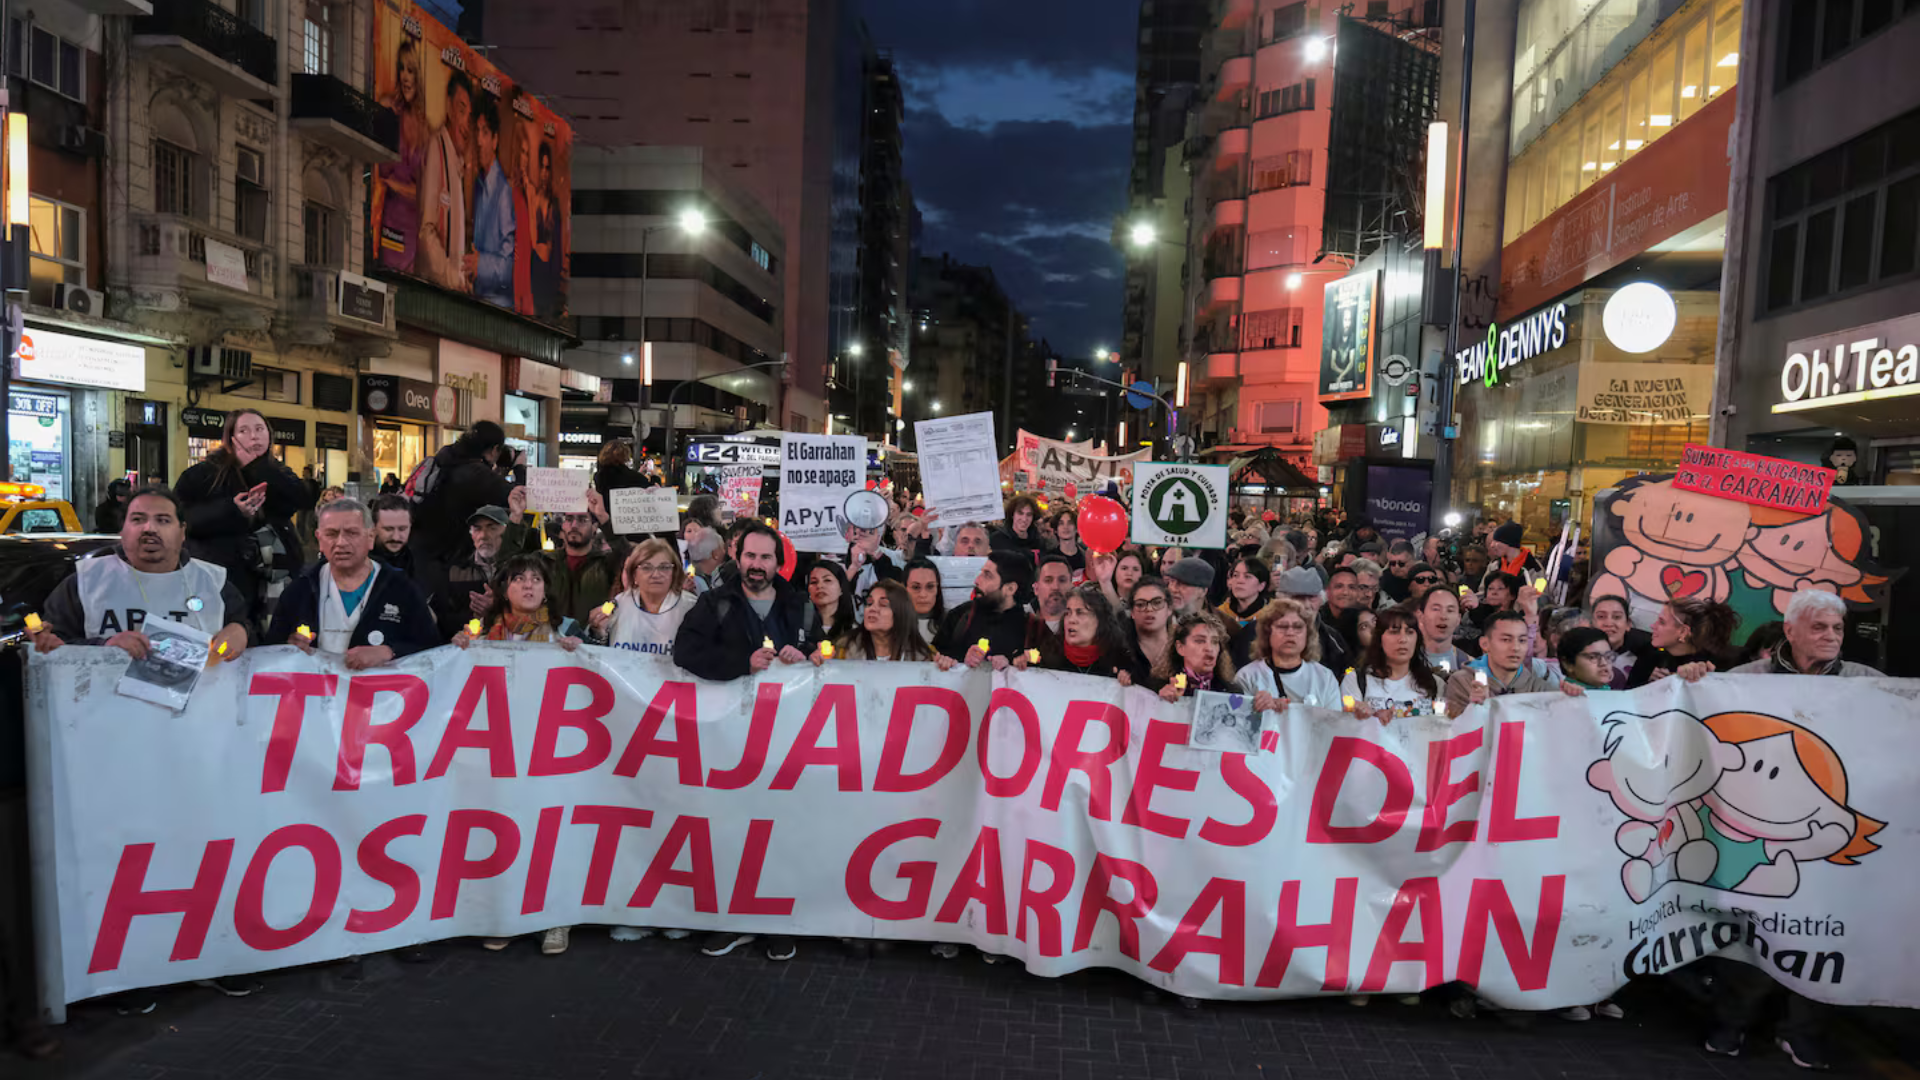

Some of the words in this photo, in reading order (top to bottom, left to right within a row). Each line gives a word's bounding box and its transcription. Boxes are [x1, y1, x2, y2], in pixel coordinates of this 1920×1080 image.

[1565, 199, 1606, 238] TEATRO
[1615, 187, 1652, 220] Instituto
[1613, 213, 1651, 247] Superior
[1652, 204, 1666, 227] de
[1666, 191, 1689, 216] Arte
[1498, 303, 1566, 370] DENNYS
[1781, 344, 1845, 402] Oh!
[1850, 337, 1919, 391] Tea
[1609, 379, 1630, 393] LA
[1633, 377, 1685, 393] NUEVA
[35, 398, 53, 411] OFF
[1579, 405, 1607, 421] DEL
[274, 431, 295, 440] IBROS
[565, 434, 602, 443] COFFEE
[702, 445, 739, 462] 24
[741, 446, 780, 455] WILDE
[787, 442, 798, 460] El
[800, 442, 856, 460] Garrahan
[787, 469, 803, 484] no
[804, 469, 817, 484] se
[819, 469, 856, 487] apaga
[1682, 448, 1732, 469] SUMATE
[1755, 459, 1827, 487] BRIGADAS
[1141, 478, 1157, 499] POSTA
[1155, 470, 1165, 480] DE
[1165, 467, 1190, 475] SALUD
[1197, 474, 1219, 504] CUIDADO
[1677, 470, 1700, 485] POR
[1701, 474, 1714, 490] EL
[1719, 474, 1825, 508] GARRAHAN
[784, 506, 836, 528] APyT
[1381, 497, 1421, 512] bonda
[615, 516, 664, 525] TRABAJADORES
[99, 608, 189, 636] APT
[249, 665, 1279, 846] TRABAJADORES
[1306, 721, 1561, 852] DEL
[87, 805, 795, 974] HOSPITAL
[845, 818, 1566, 991] GARRAHAN
[1629, 894, 1682, 940] Hospital
[1623, 920, 1845, 984] Garrahan
